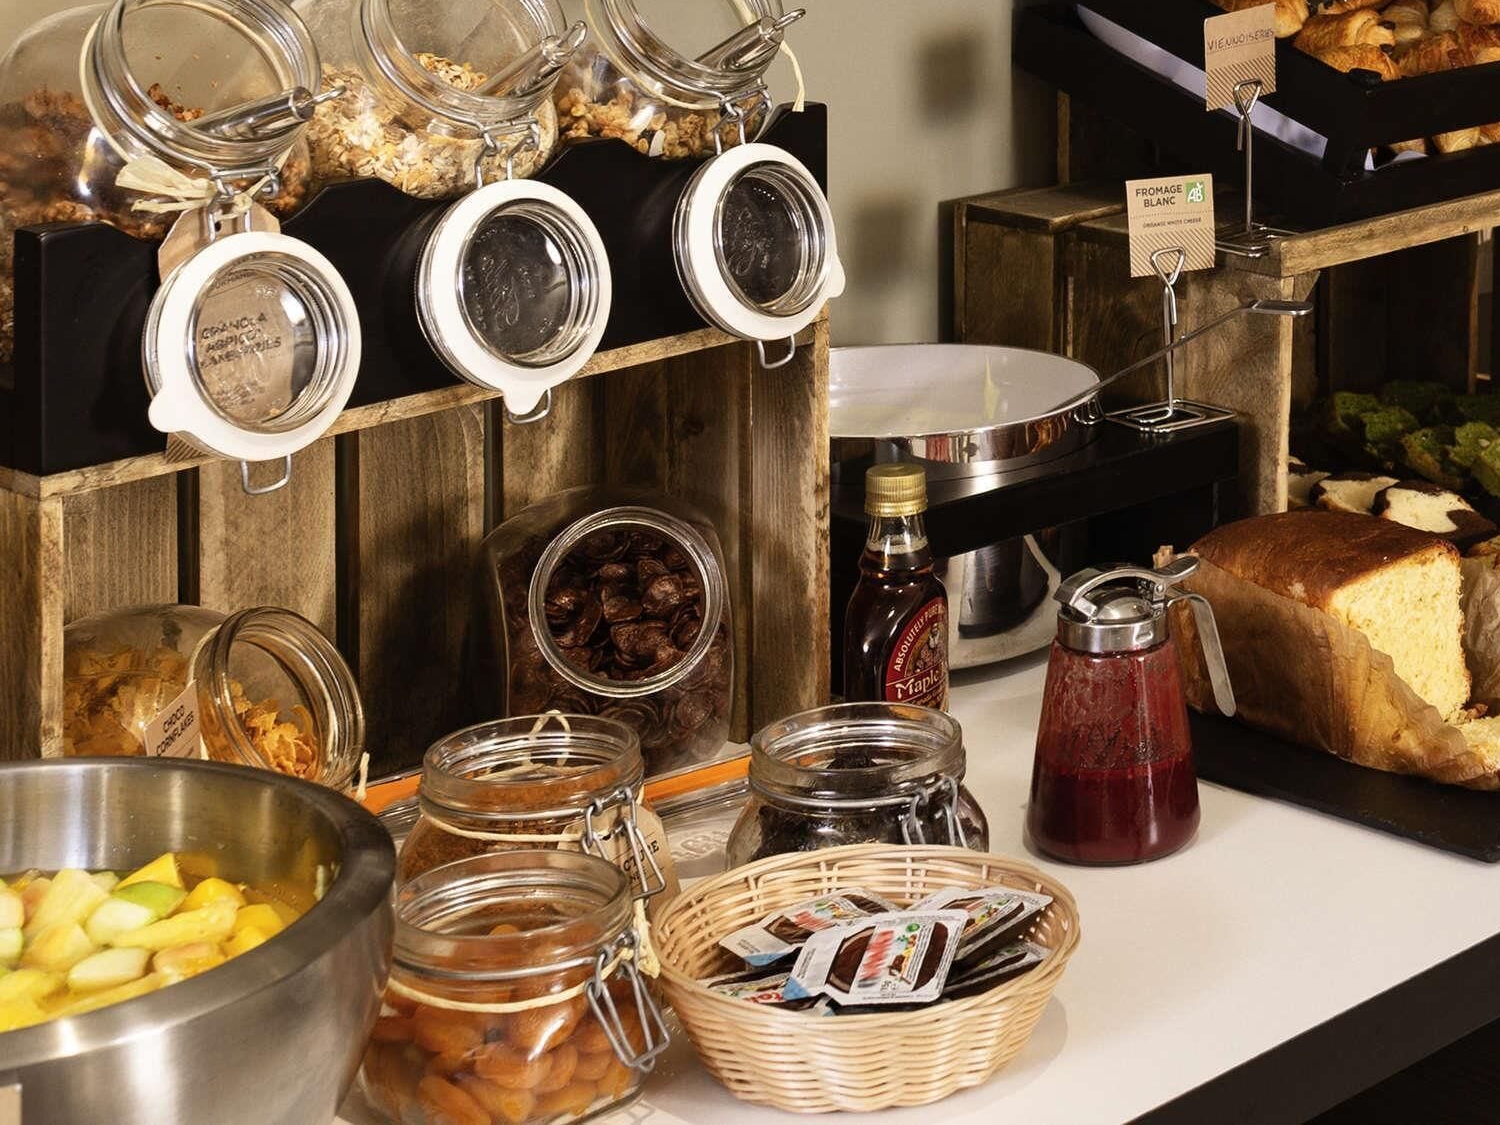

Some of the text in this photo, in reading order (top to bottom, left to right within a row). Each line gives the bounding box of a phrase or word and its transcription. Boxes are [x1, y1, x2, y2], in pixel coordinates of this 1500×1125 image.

[1135, 184, 1183, 198] FROMAGE
[1144, 196, 1176, 208] BLANC
[893, 616, 924, 672] ABSOLUTELY
